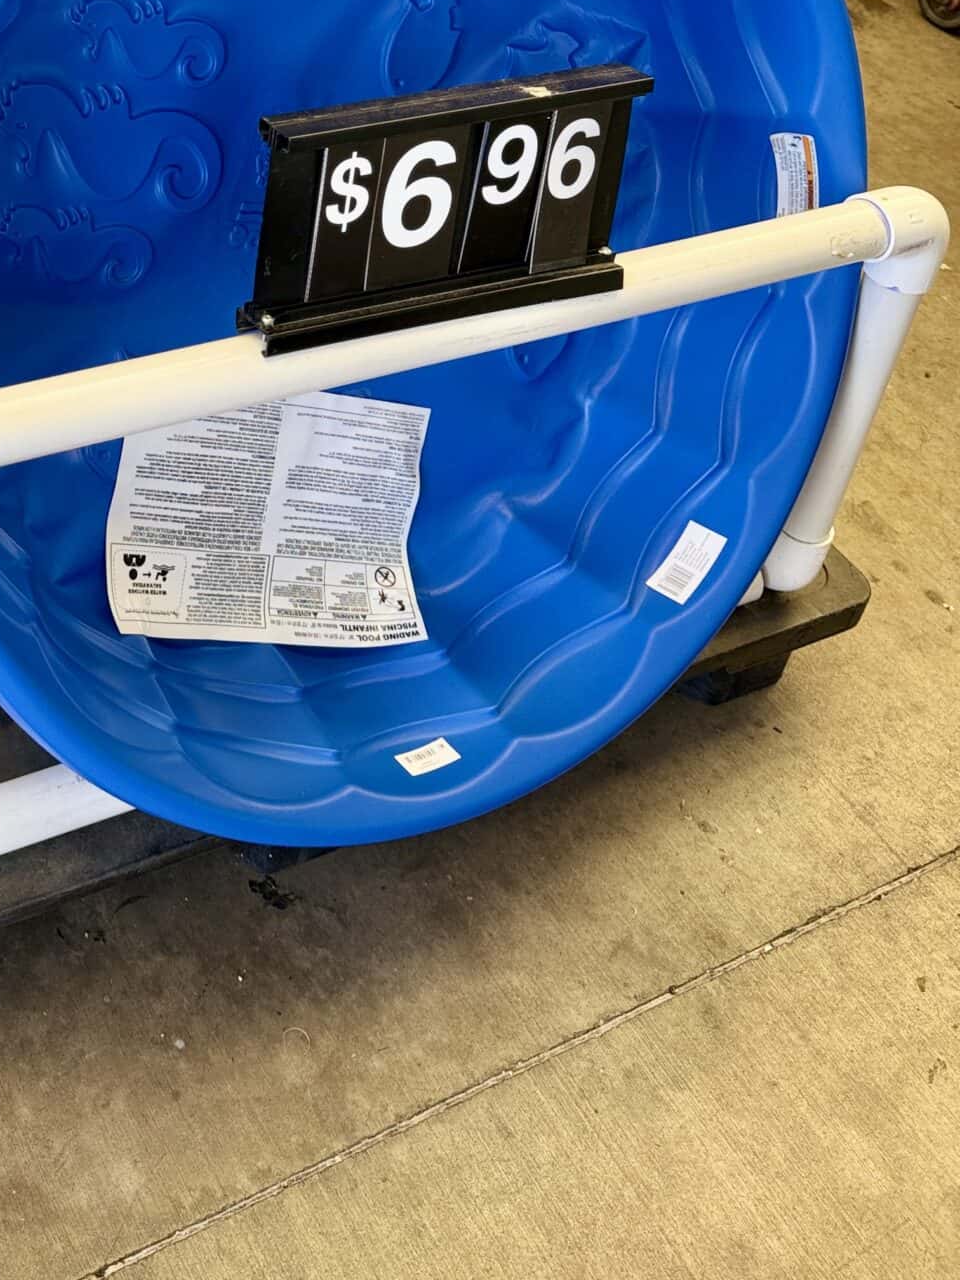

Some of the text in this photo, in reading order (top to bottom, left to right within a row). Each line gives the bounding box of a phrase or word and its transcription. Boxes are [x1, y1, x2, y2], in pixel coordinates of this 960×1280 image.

[339, 623, 377, 632] INFANTIL
[378, 621, 418, 631] PISCINA
[358, 633, 380, 642] POOL
[382, 631, 421, 641] WADING
